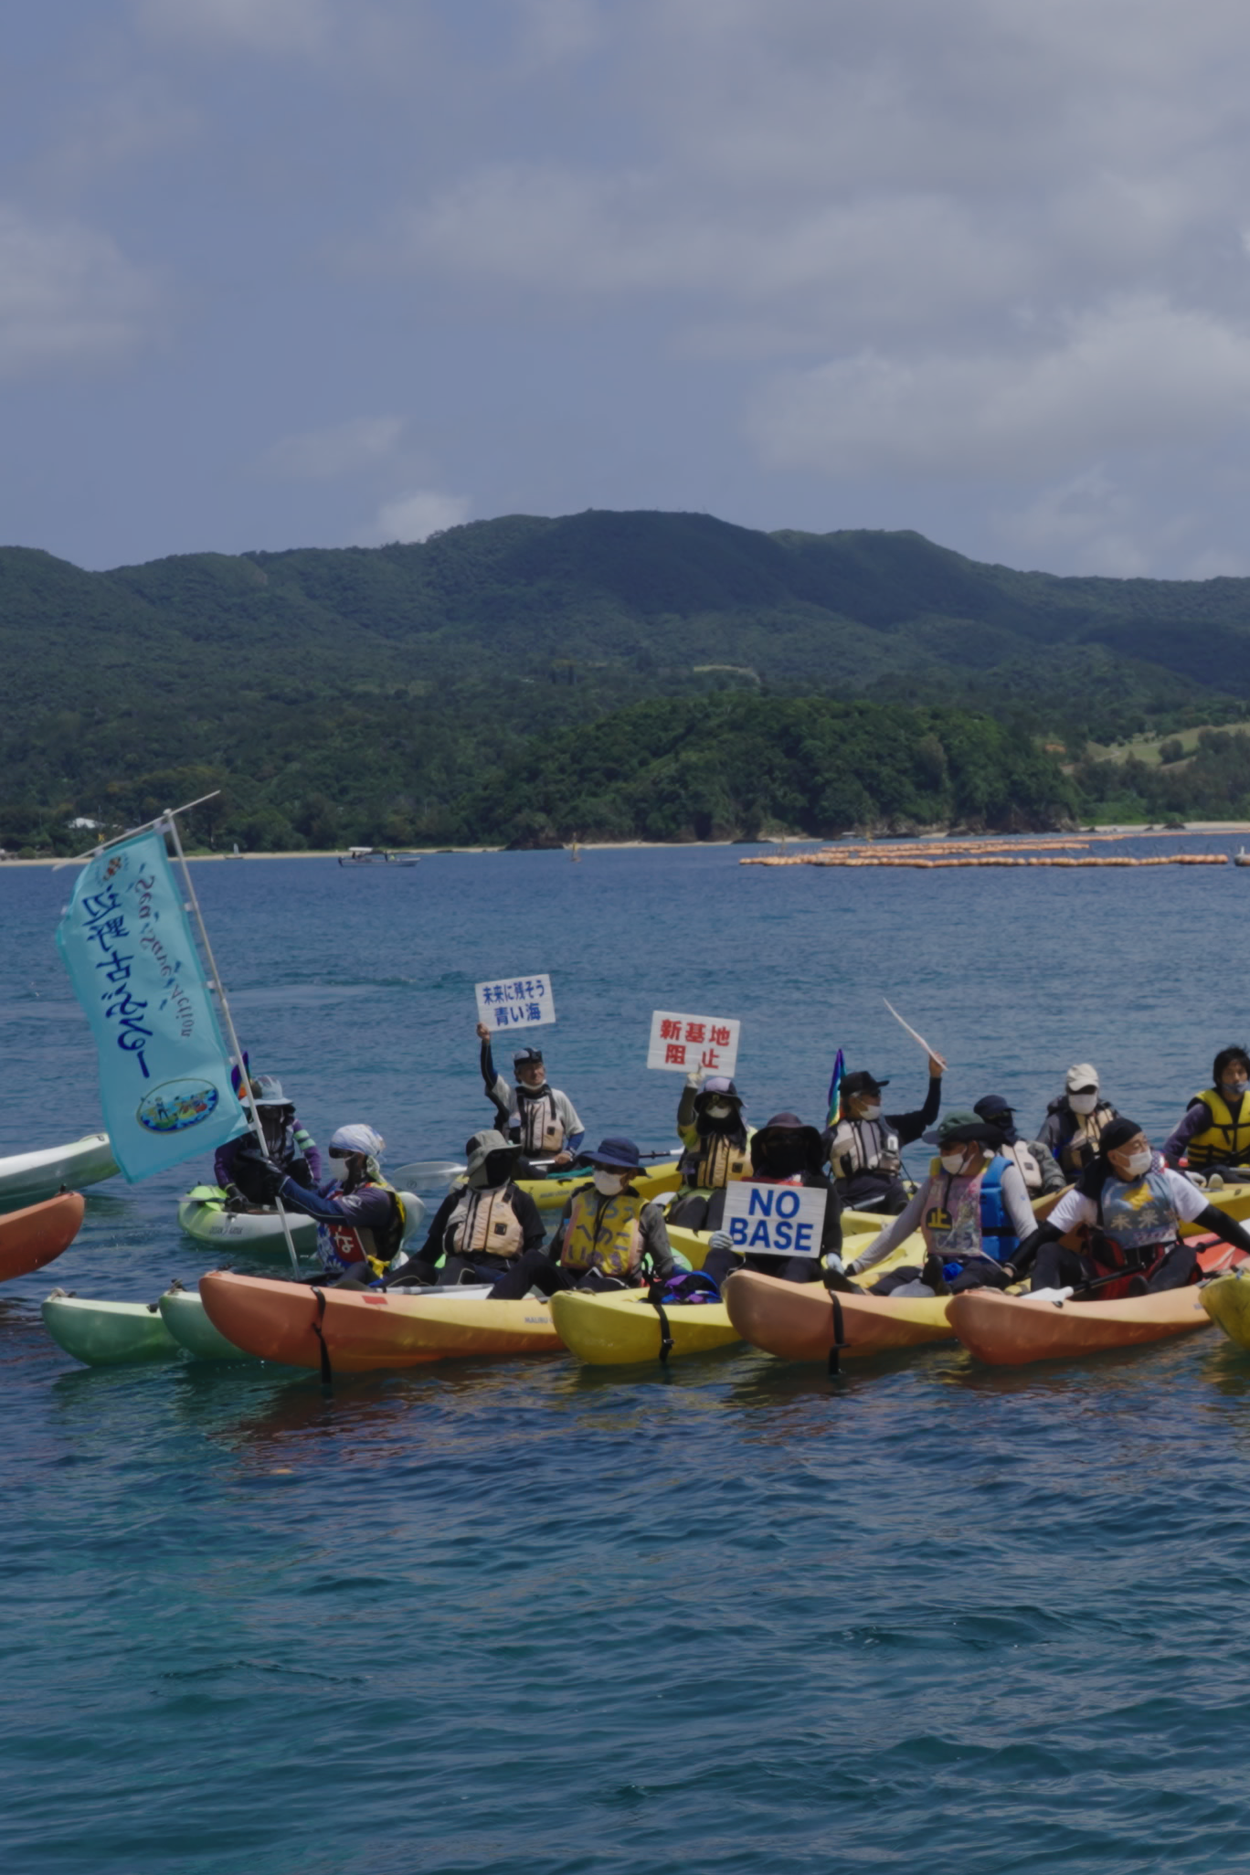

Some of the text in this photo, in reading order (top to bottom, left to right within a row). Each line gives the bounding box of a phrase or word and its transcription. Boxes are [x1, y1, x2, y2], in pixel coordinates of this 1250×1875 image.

[482, 979, 546, 1005] 未来に残そう
[494, 1002, 542, 1027] 青い海
[659, 1018, 731, 1048] 新基地
[664, 1043, 720, 1070] 阻止
[747, 1188, 801, 1219] NO
[728, 1216, 815, 1252] BASE
